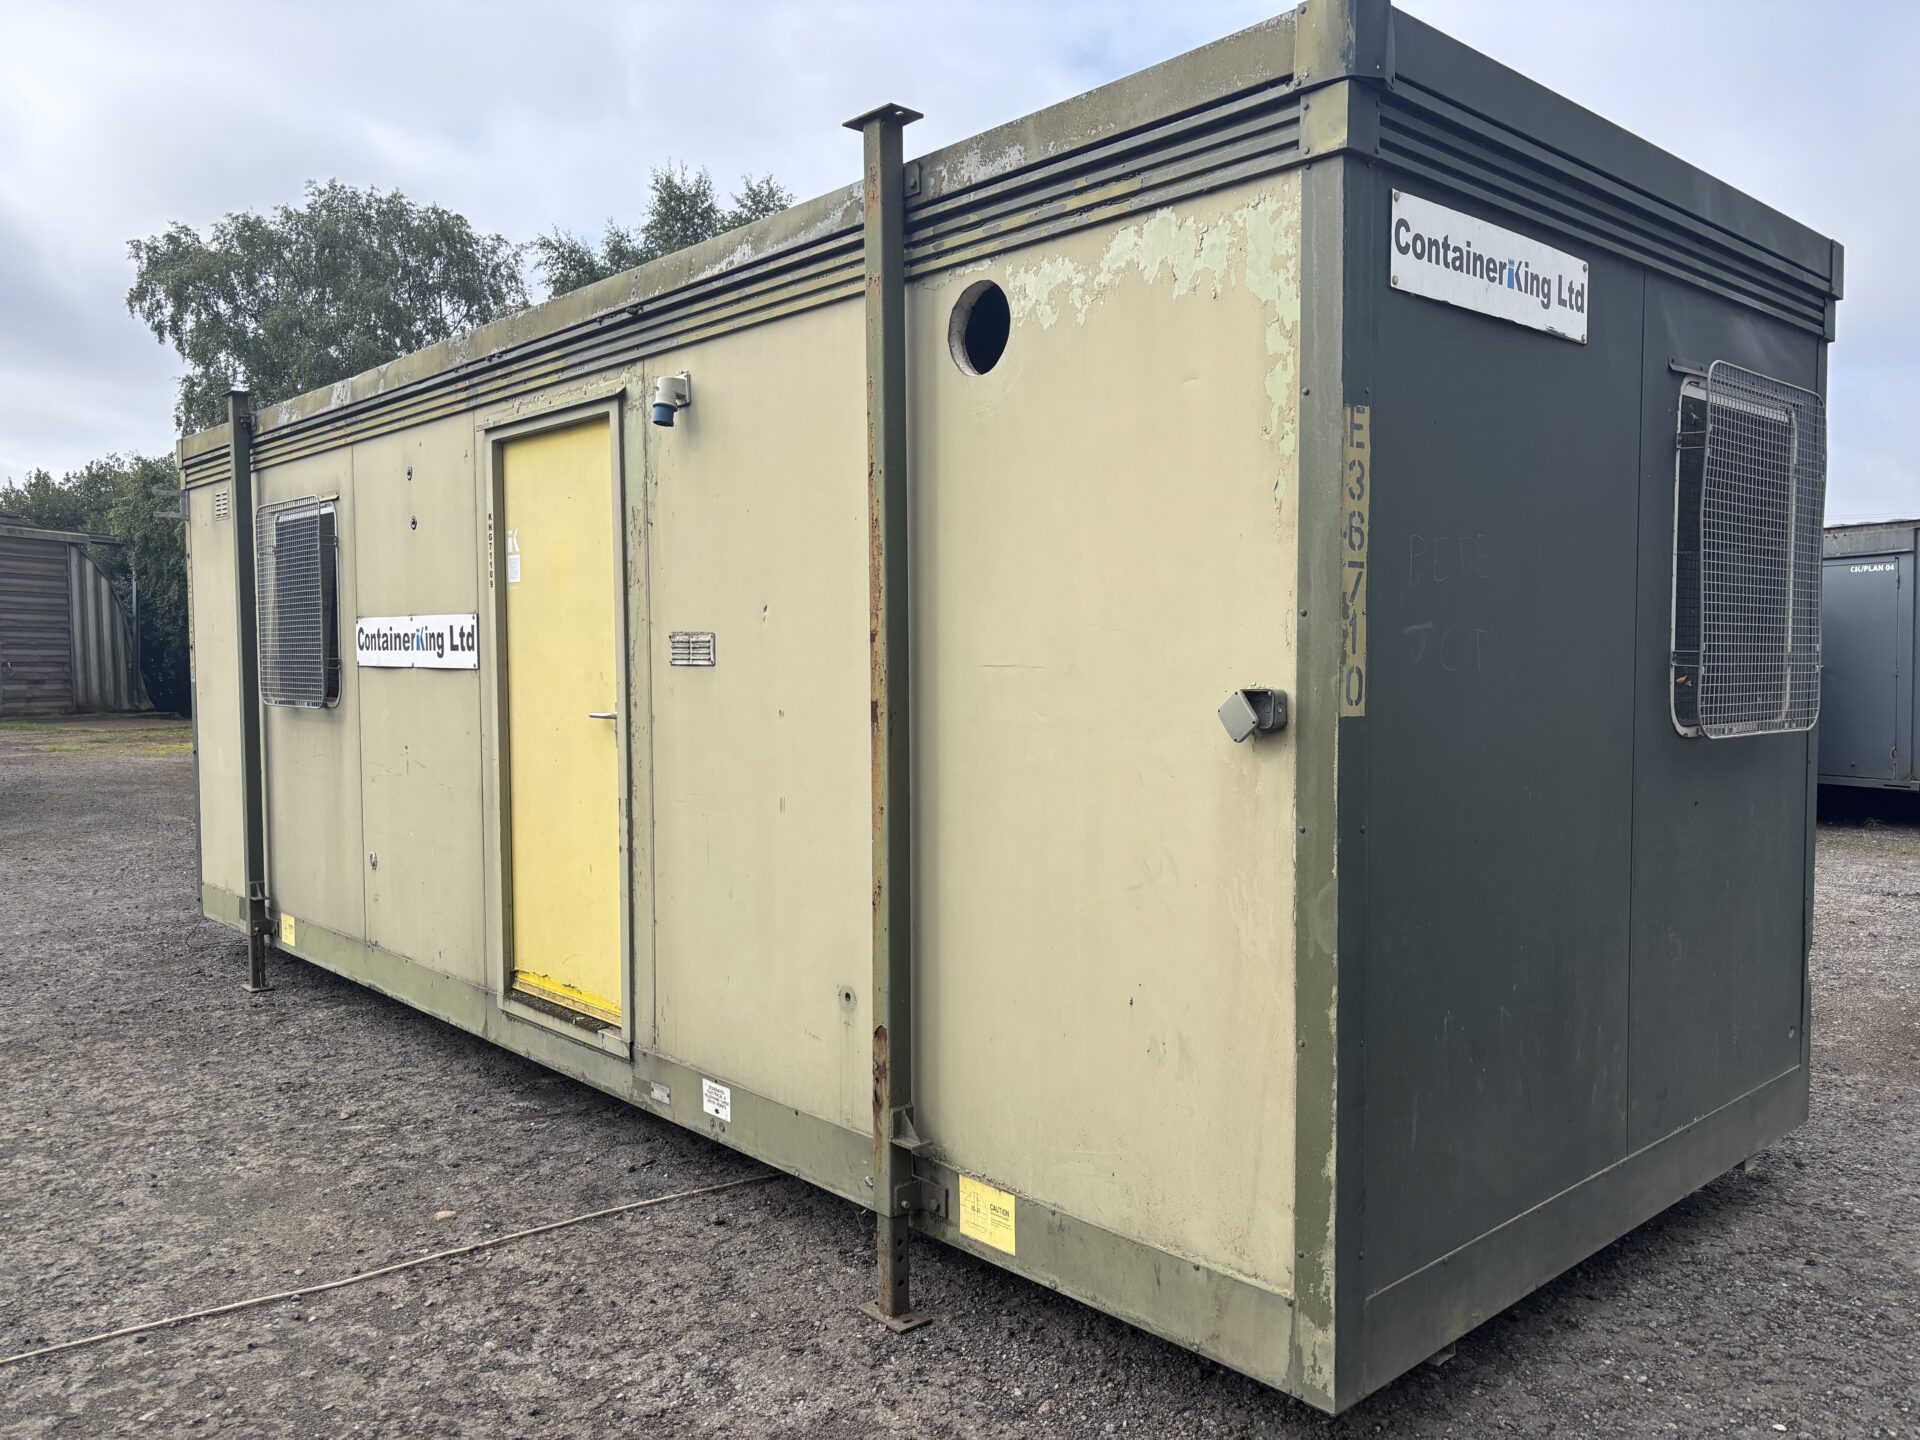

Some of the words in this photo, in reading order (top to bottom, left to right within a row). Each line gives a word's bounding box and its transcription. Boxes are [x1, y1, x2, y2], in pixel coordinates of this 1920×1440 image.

[1557, 274, 1585, 314] Ltd
[449, 624, 476, 651] Ltd
[989, 1203, 1010, 1218] CAUTION
